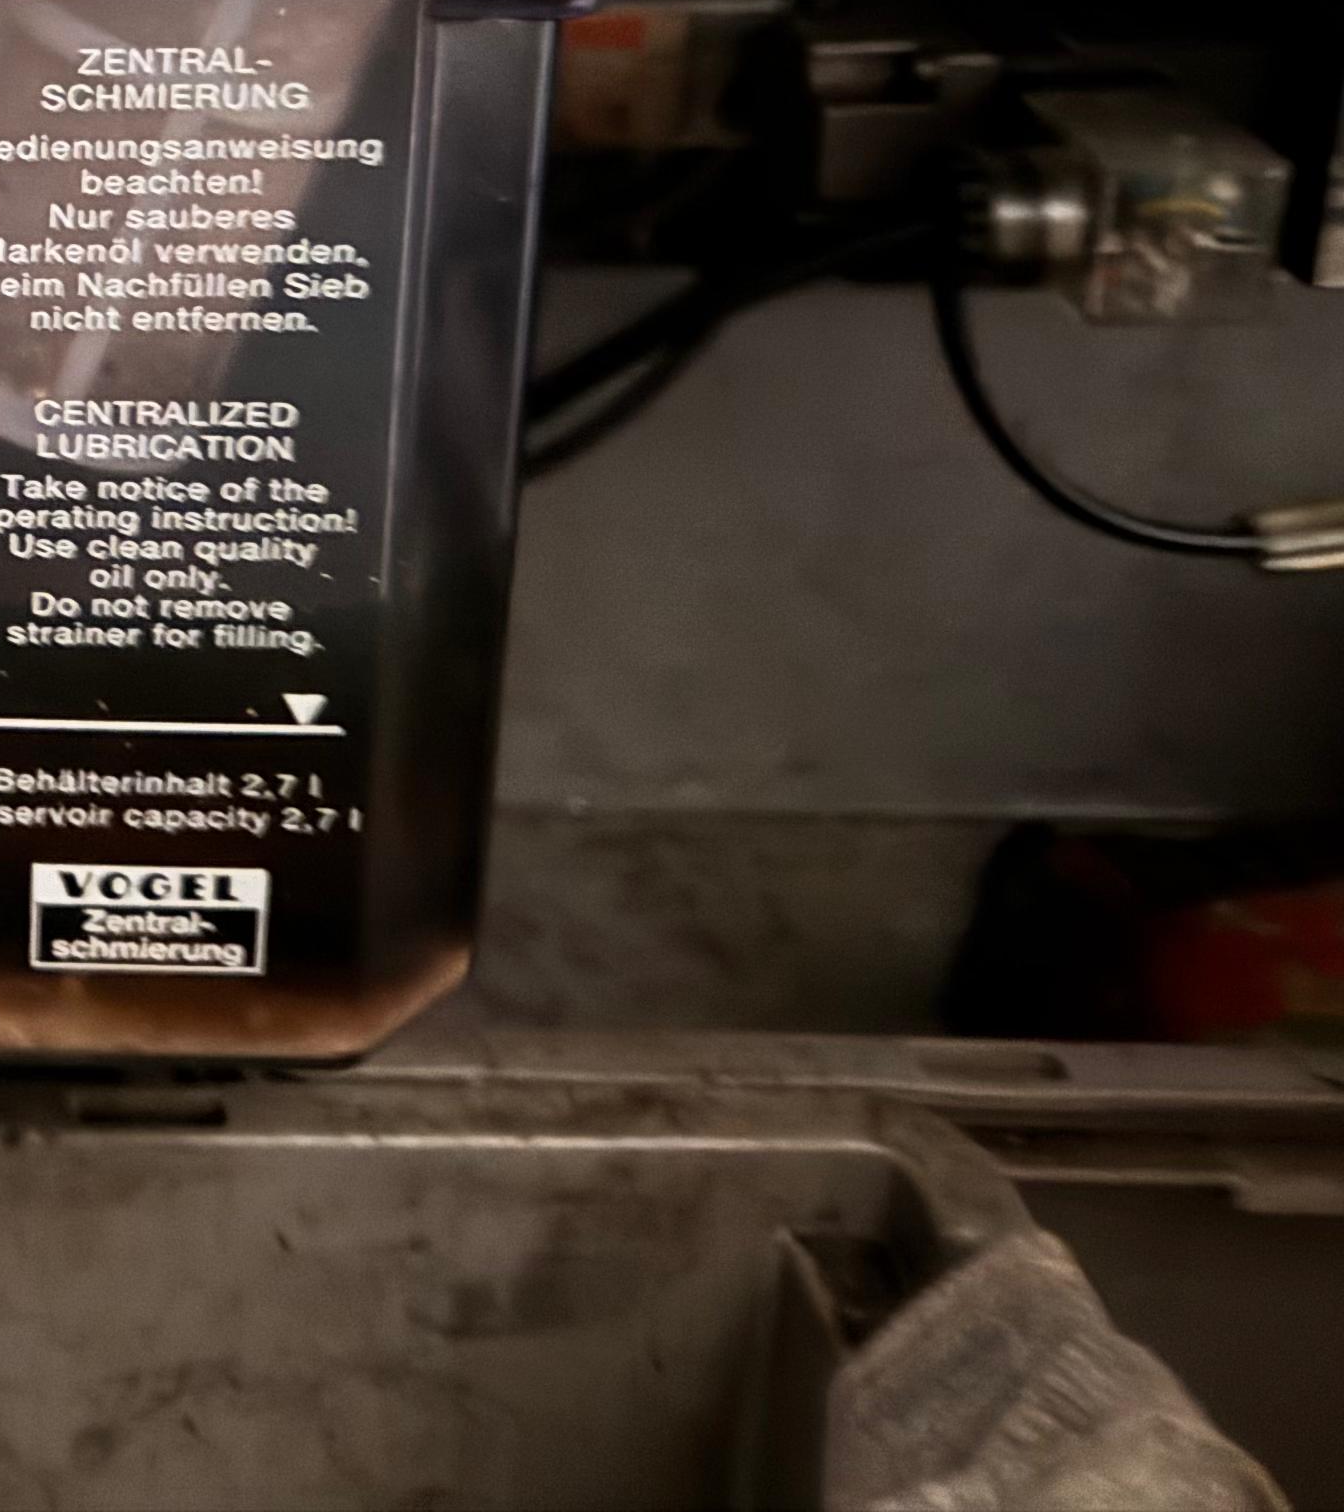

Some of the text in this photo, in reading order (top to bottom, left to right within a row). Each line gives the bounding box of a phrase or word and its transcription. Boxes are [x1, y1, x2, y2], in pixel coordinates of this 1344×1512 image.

[78, 47, 274, 78] ZENTRAL-
[40, 82, 310, 112] SCHMIERUNG
[81, 170, 263, 196] beachten!
[49, 204, 297, 231] Nur sauberes
[154, 239, 369, 266] verwenden.
[78, 272, 272, 300] Nachfüllen
[283, 272, 370, 300] Sieb
[30, 306, 319, 333] nicht entfernen.
[34, 399, 300, 429] CENTRALIZED
[36, 433, 296, 462] LUBRICATION
[0, 474, 330, 504] Take notice of the
[151, 506, 358, 534] instruction!
[8, 533, 320, 568] Use clean quality
[89, 563, 233, 593] oil only.
[30, 591, 293, 623] Do not remove
[6, 621, 325, 653] strainer for filling.
[122, 804, 270, 837] capacity
[58, 870, 242, 903] VOGEL
[82, 908, 218, 935] Zentral-
[51, 935, 247, 967] schmierung
